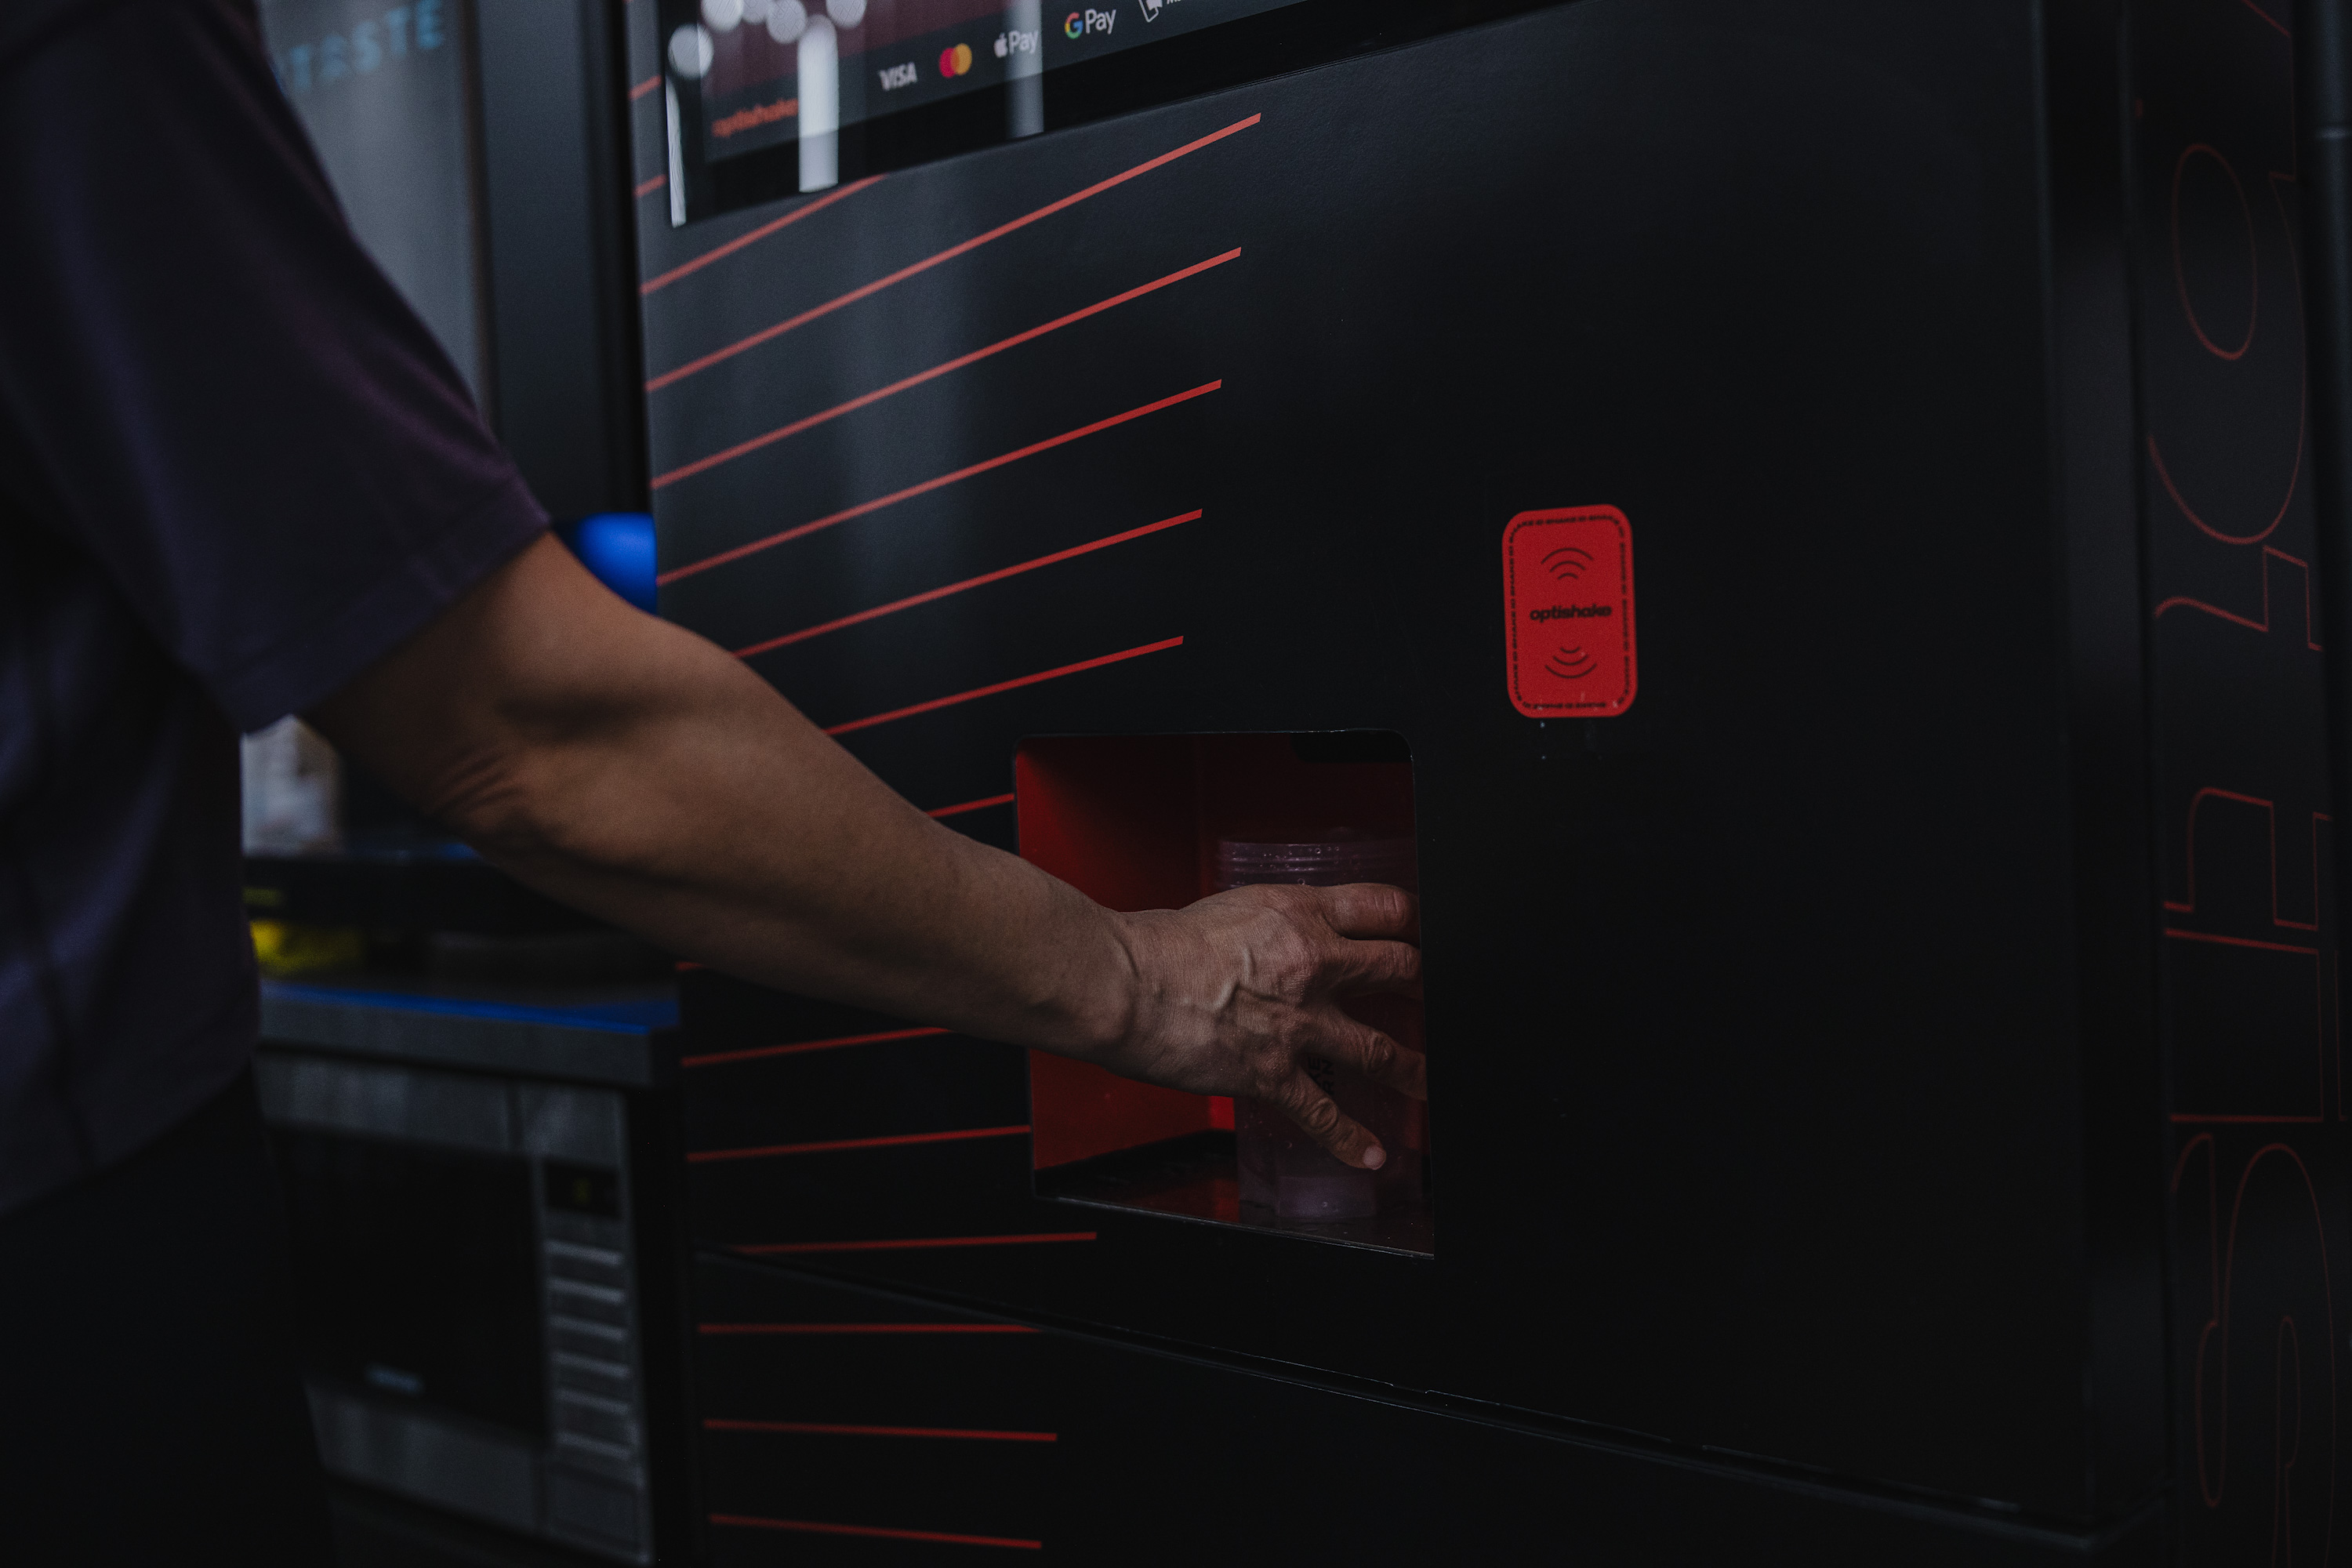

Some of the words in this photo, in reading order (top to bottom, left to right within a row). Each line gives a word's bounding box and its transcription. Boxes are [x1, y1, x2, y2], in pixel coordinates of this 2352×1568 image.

[1008, 31, 1038, 55] Pay
[879, 61, 917, 91] VISA
[1530, 603, 1613, 623] optishake
[1322, 1059, 1334, 1096] RN
